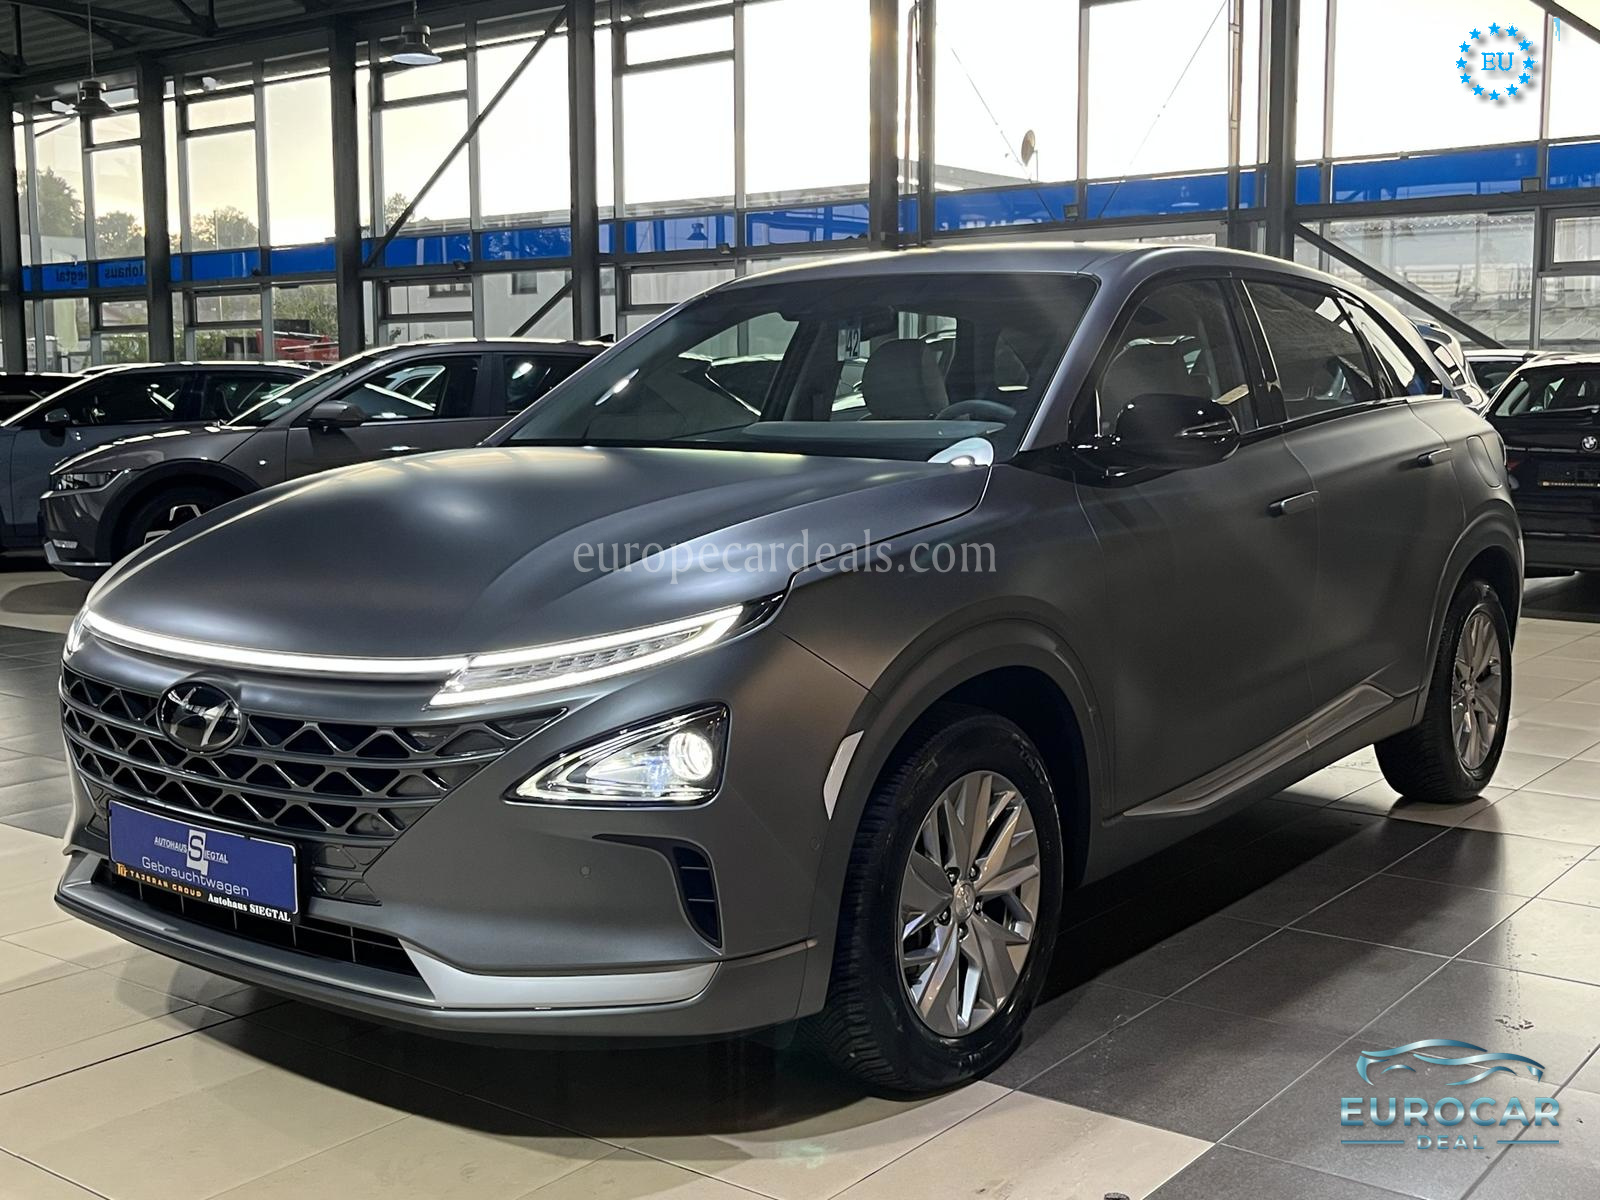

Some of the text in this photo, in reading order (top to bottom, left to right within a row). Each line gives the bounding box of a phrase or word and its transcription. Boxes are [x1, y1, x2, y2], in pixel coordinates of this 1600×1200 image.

[154, 836, 188, 854] AUTOHAUS
[141, 856, 249, 897] Gebrauchtwagen
[171, 883, 202, 898] GROUP
[207, 893, 291, 922] Autohaus SIEGTAL
